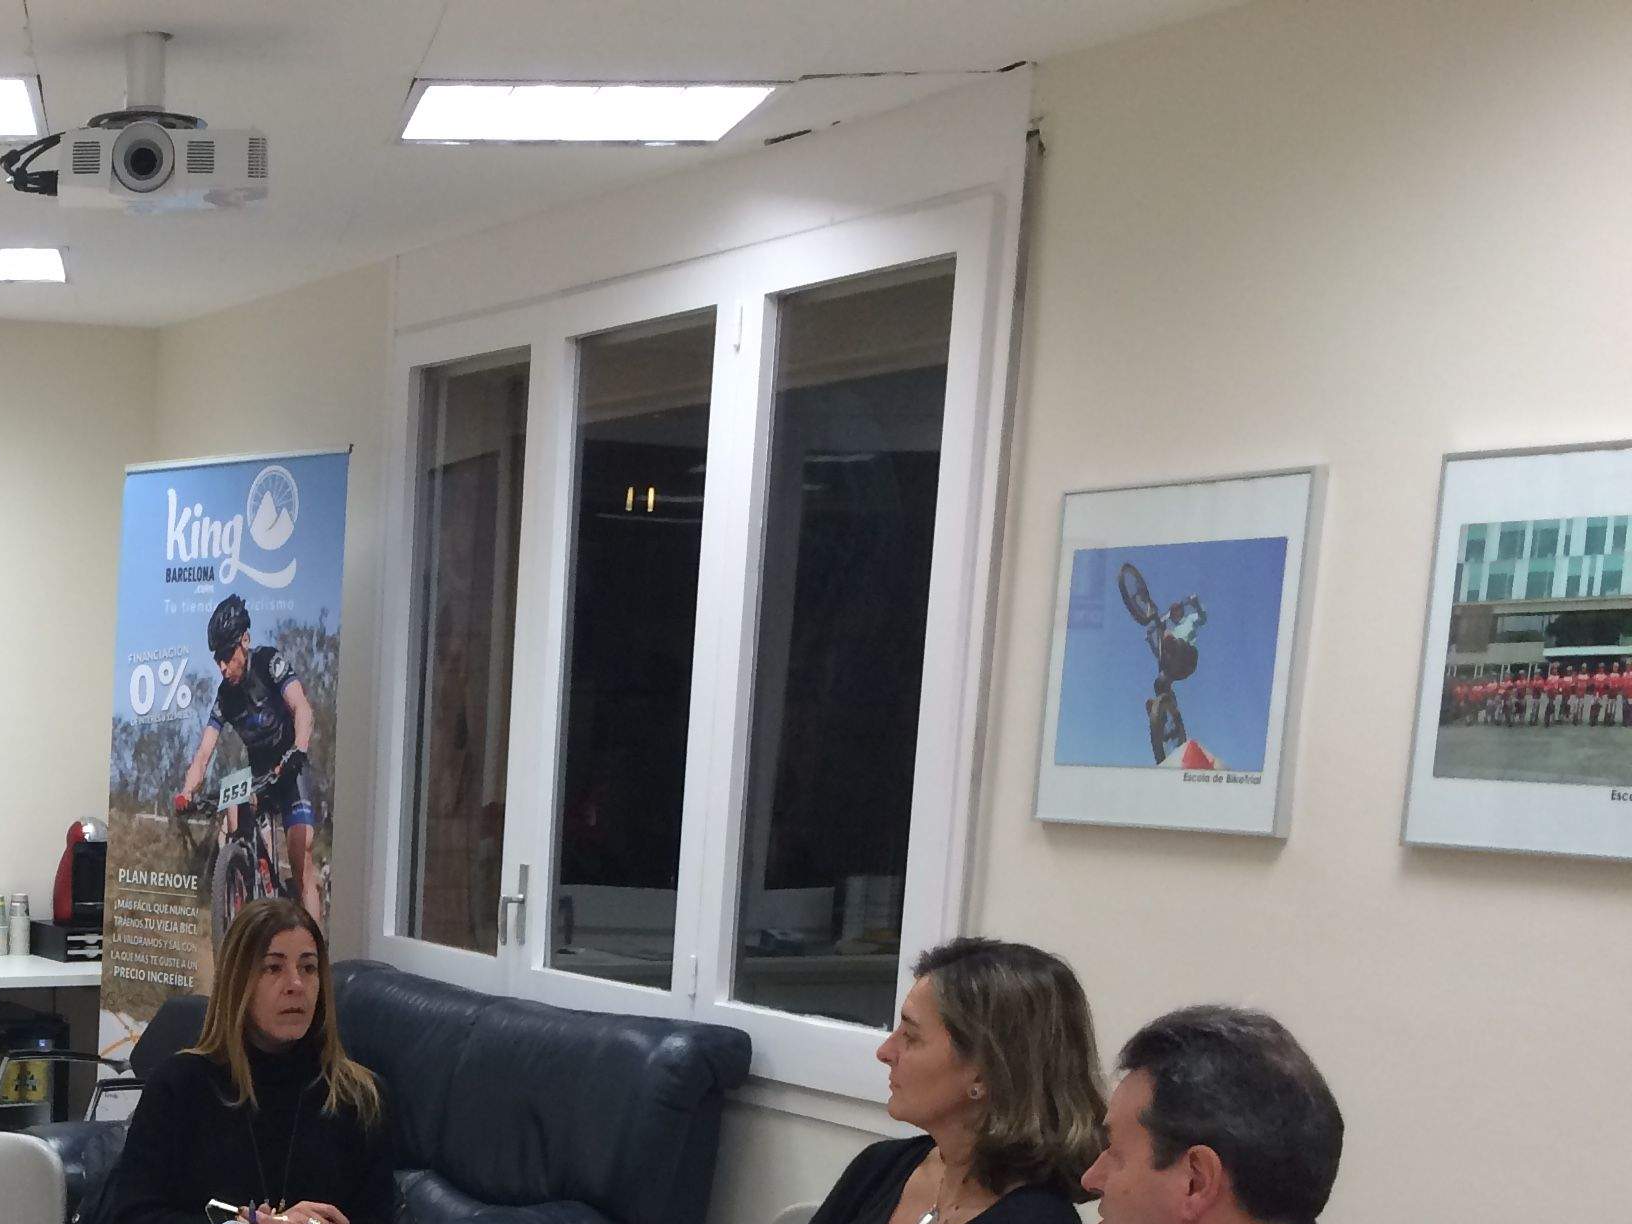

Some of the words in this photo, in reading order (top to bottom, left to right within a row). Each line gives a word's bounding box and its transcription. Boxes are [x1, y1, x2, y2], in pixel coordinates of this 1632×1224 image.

[165, 566, 215, 583] BARCELONA
[129, 664, 192, 716] 0%
[1212, 774, 1223, 783] de
[222, 781, 248, 803] 553
[118, 868, 148, 886] PLAN
[150, 871, 198, 890] RENOVE
[153, 903, 169, 915] QUE
[144, 917, 155, 930] TU
[156, 919, 178, 933] VIEJA
[112, 933, 122, 943] LA
[110, 950, 120, 960] LA
[120, 951, 133, 962] QUE
[150, 955, 158, 966] TE
[113, 965, 146, 981] PRECIO
